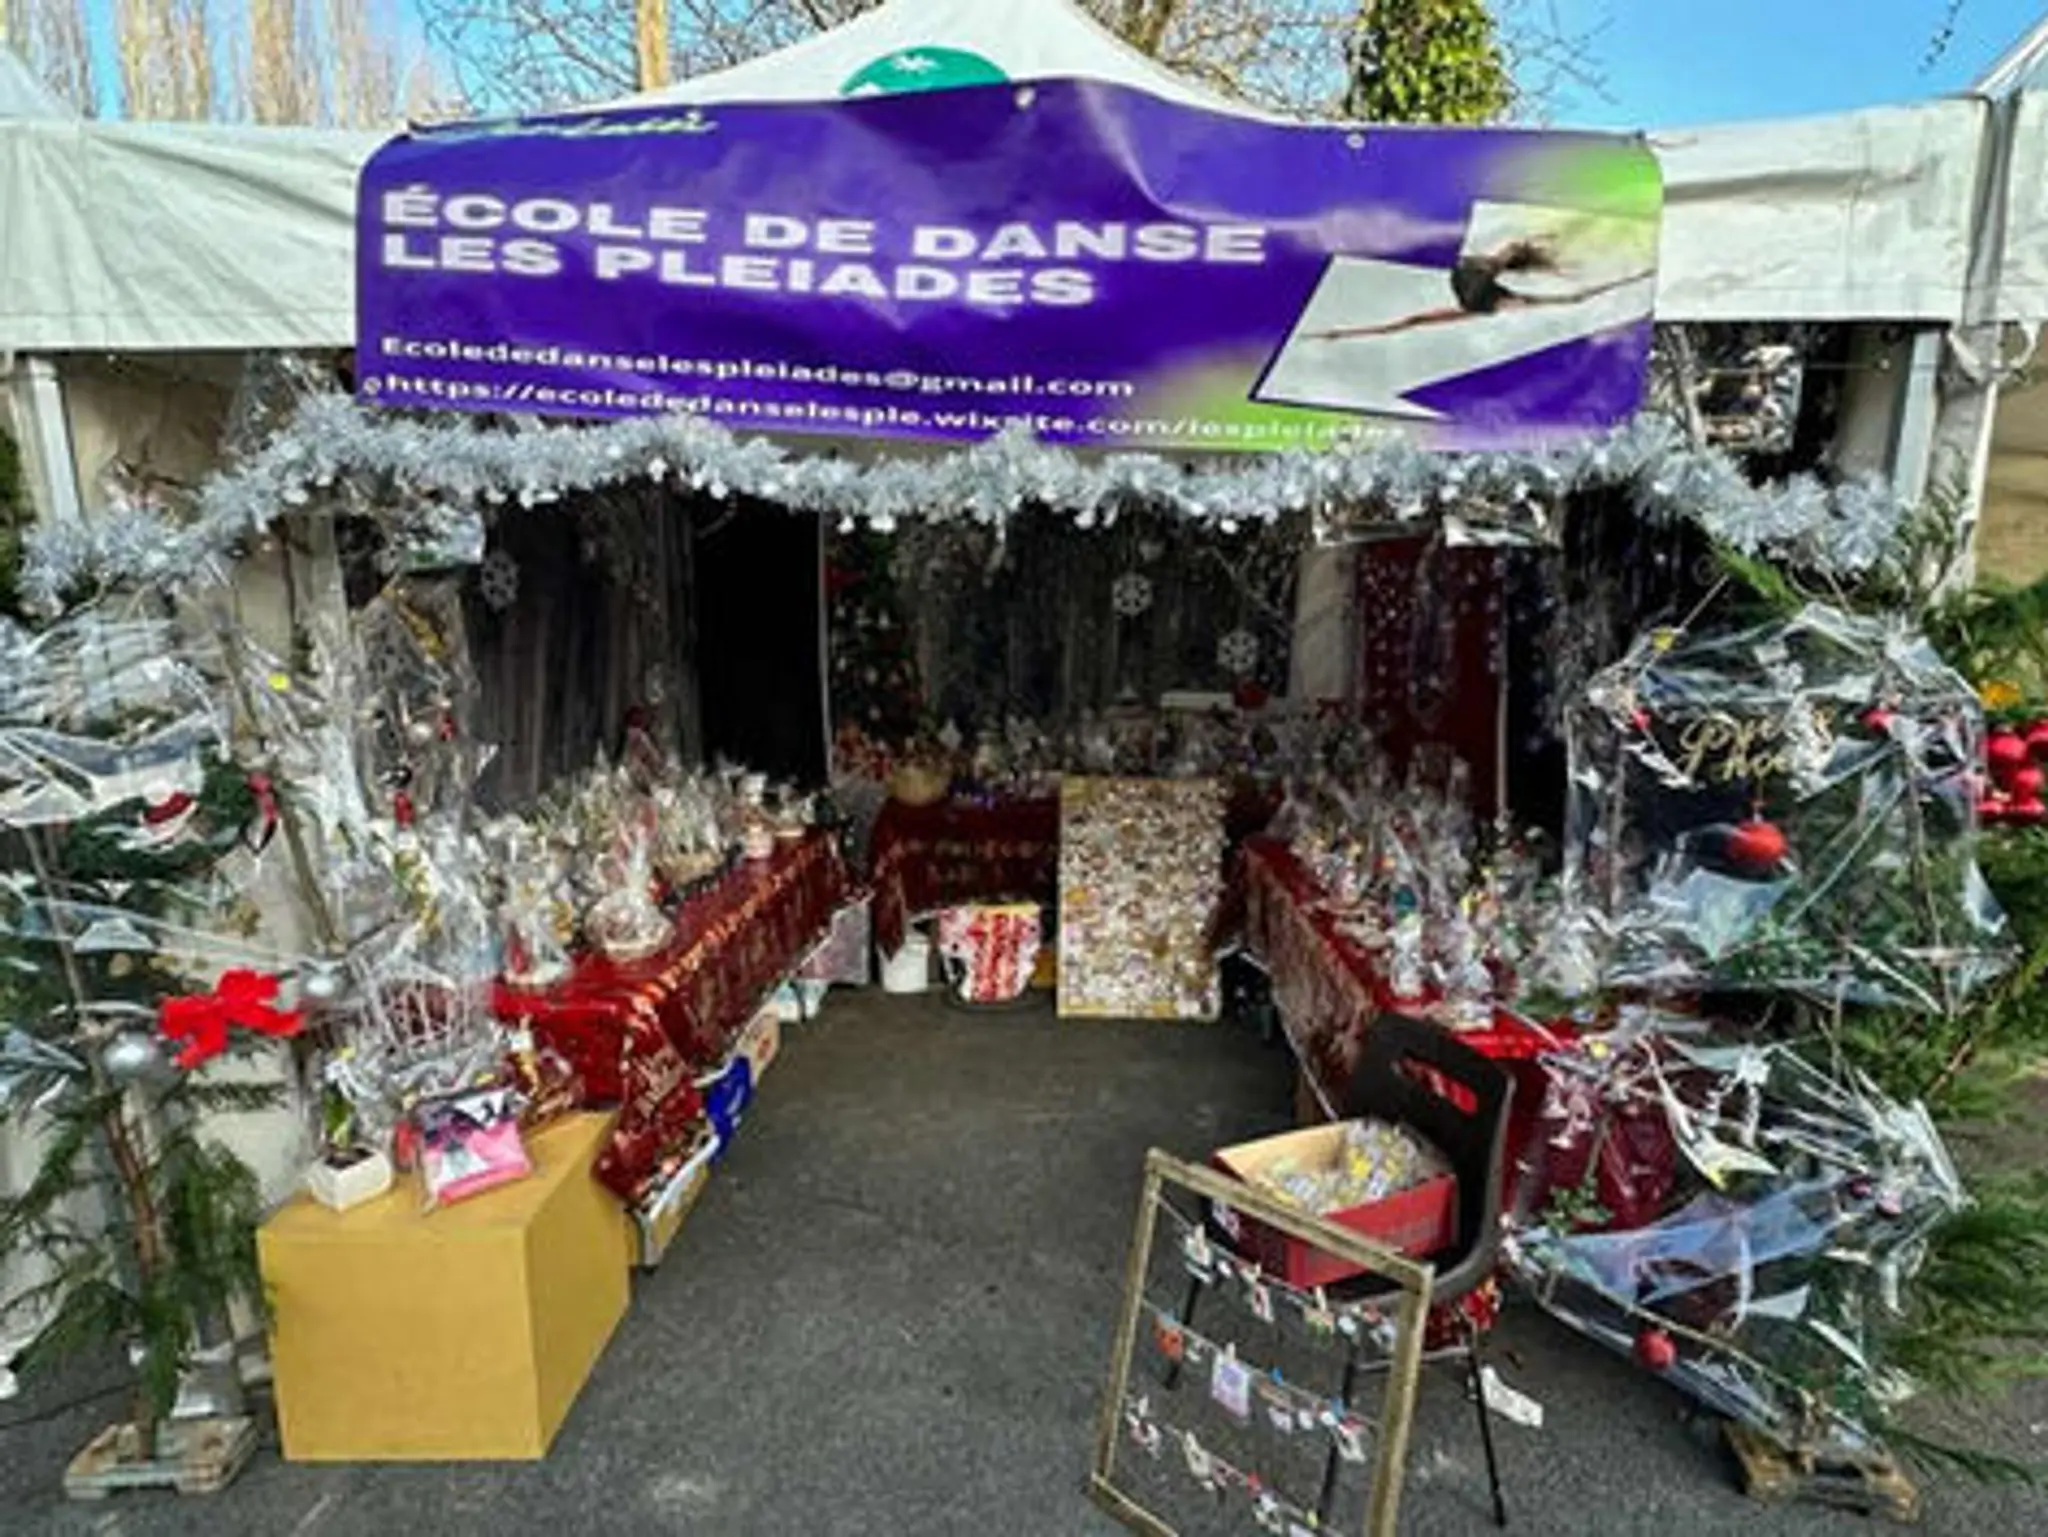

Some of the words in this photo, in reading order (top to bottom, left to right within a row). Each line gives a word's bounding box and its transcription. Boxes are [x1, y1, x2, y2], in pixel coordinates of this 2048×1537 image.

[383, 184, 707, 242] ÉCOLE
[744, 212, 874, 253] DE
[913, 221, 1266, 263] DANSE
[383, 233, 561, 276] LES
[596, 245, 1094, 305] PLEIADES
[381, 337, 1135, 397] Ecolededanselespleiades@gmail.com
